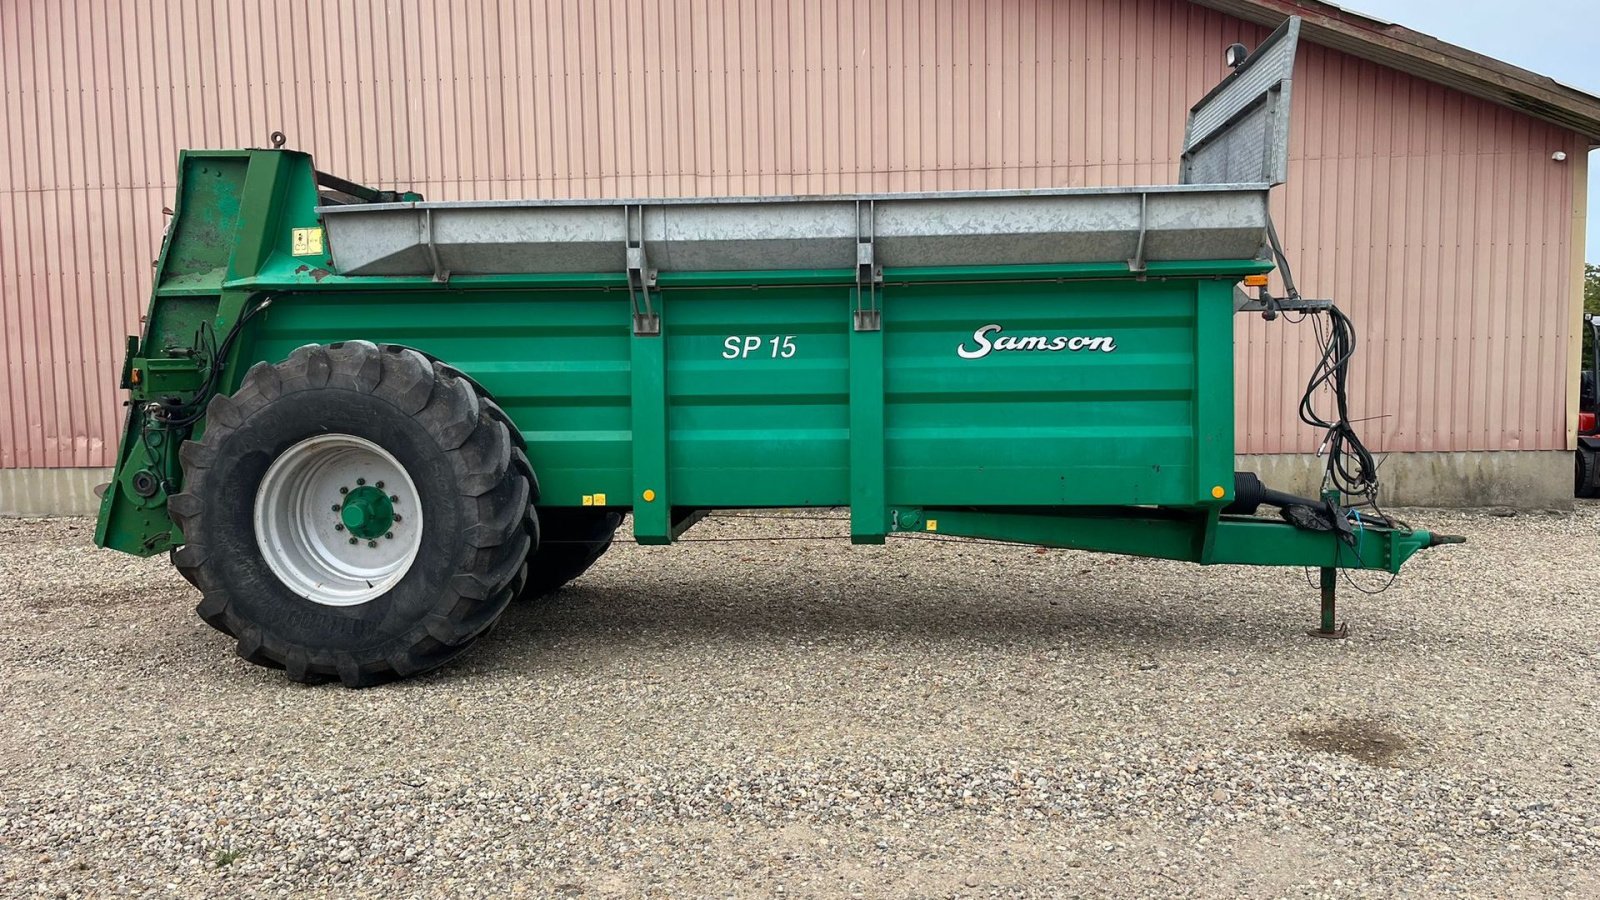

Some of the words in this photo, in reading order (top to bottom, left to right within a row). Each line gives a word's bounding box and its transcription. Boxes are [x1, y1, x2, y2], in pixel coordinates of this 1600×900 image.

[722, 335, 762, 359] SP
[769, 335, 797, 359] 15
[957, 323, 1117, 360] Samson
